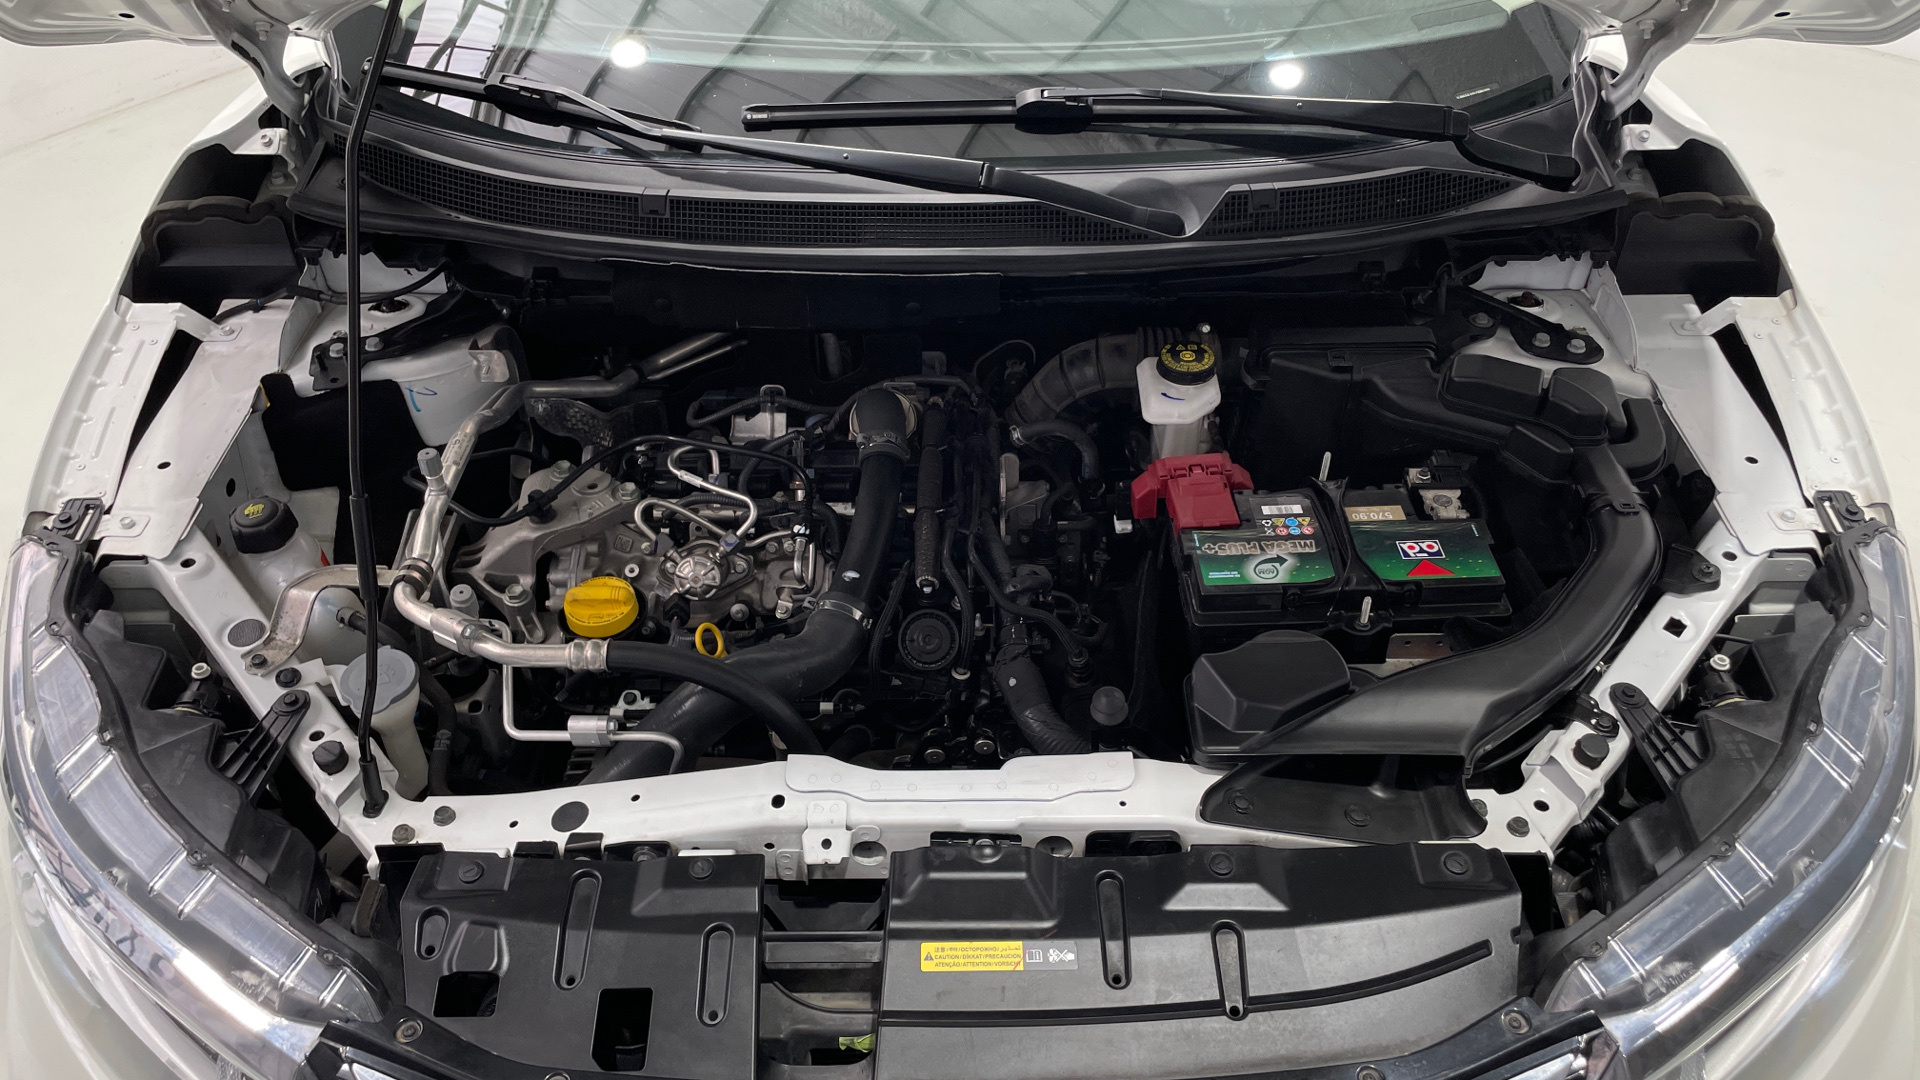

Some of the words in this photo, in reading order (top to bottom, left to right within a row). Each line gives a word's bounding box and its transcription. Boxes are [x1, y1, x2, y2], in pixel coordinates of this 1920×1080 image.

[1352, 512, 1393, 520] 570.90
[1202, 541, 1261, 555] PLUS+
[1262, 539, 1316, 554] MEGA
